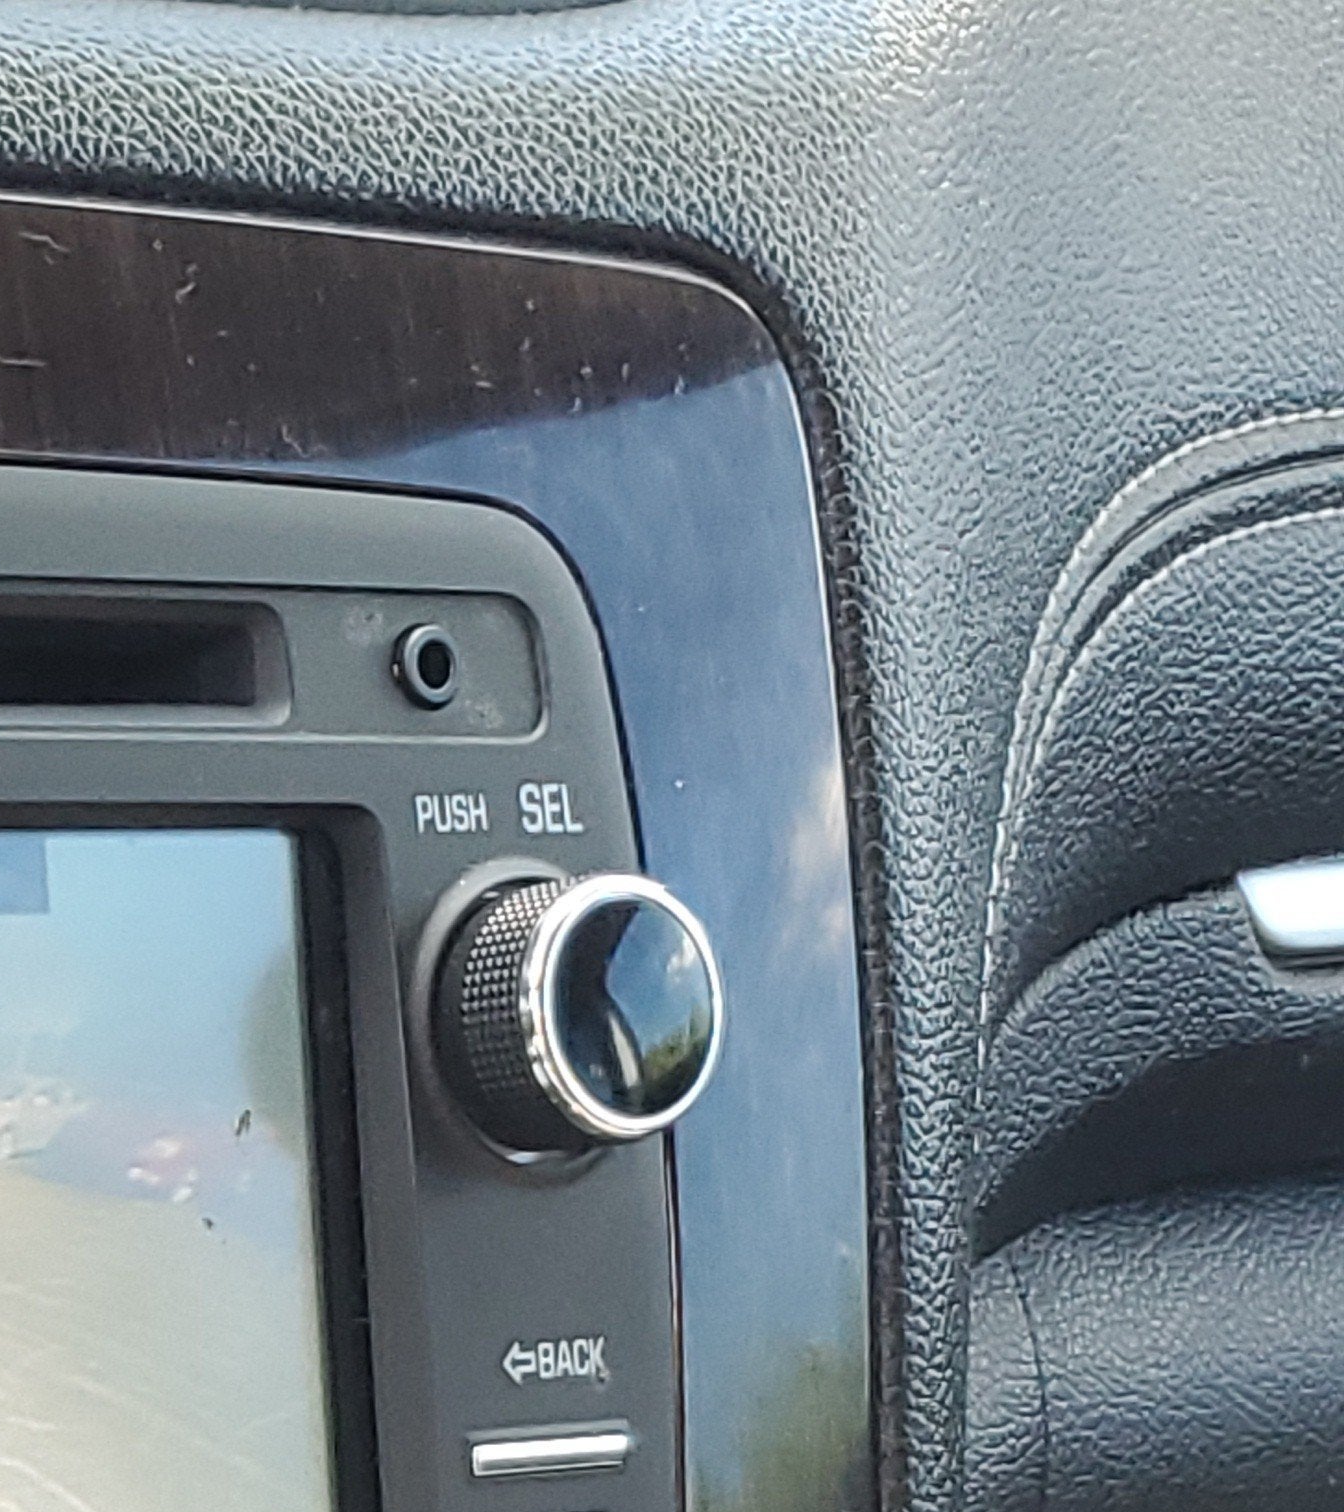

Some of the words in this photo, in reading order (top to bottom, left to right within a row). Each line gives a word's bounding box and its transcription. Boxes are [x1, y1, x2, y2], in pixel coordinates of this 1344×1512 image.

[415, 793, 489, 834] PUSH
[518, 783, 584, 834] SEL
[536, 1336, 609, 1379] BACK
